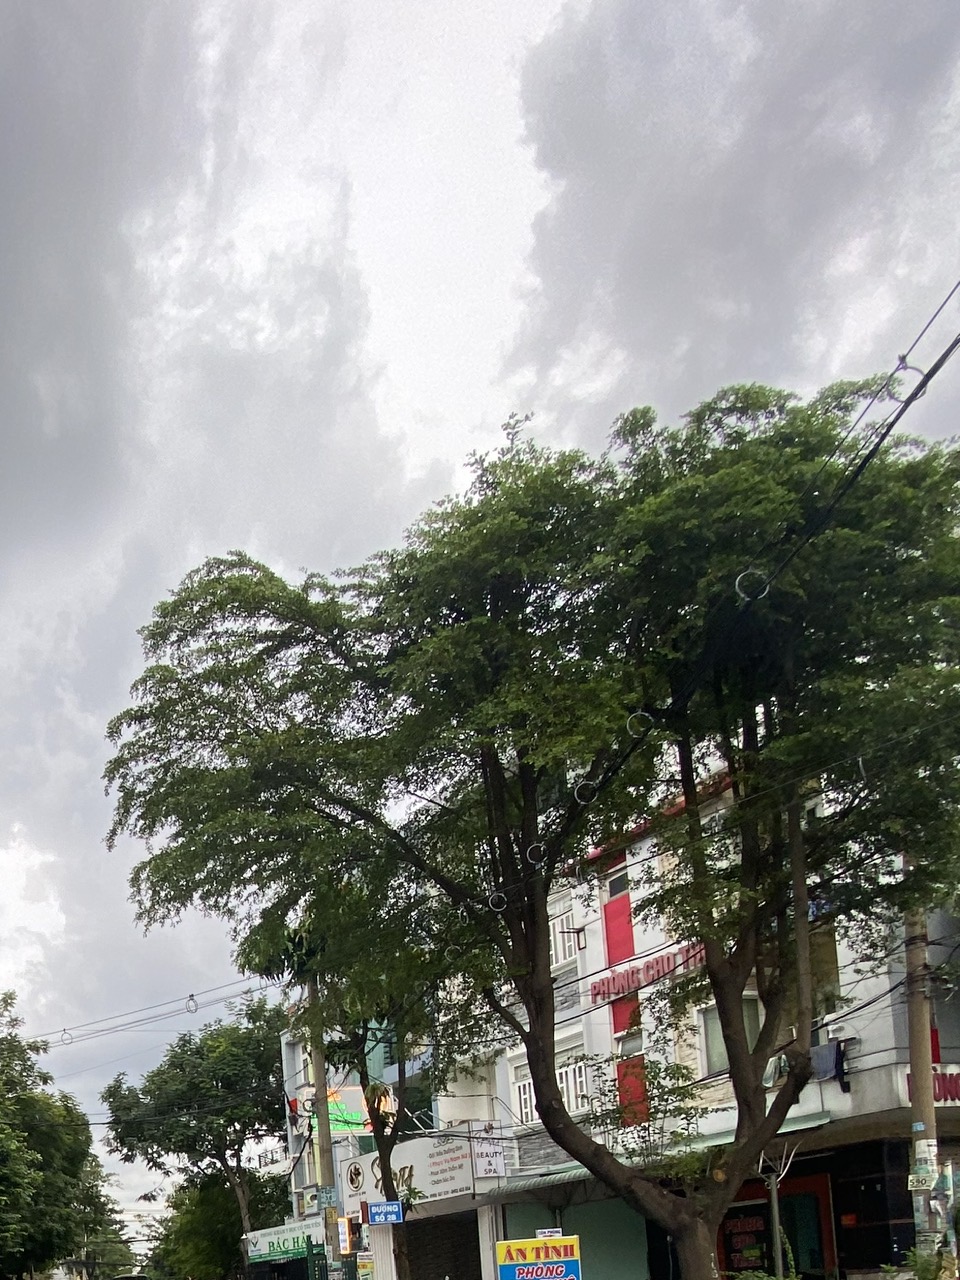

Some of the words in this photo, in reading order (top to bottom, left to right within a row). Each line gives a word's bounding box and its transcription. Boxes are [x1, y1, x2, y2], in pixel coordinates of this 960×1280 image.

[590, 968, 641, 1004] PHÒNG
[642, 951, 676, 983] CHO
[476, 1151, 502, 1159] BEAUTY
[375, 1213, 385, 1222] SỐ
[268, 1237, 289, 1252] BÁC
[503, 1244, 527, 1263] ÂN
[531, 1242, 575, 1261] TÌNH
[515, 1262, 565, 1280] PHÒNG
